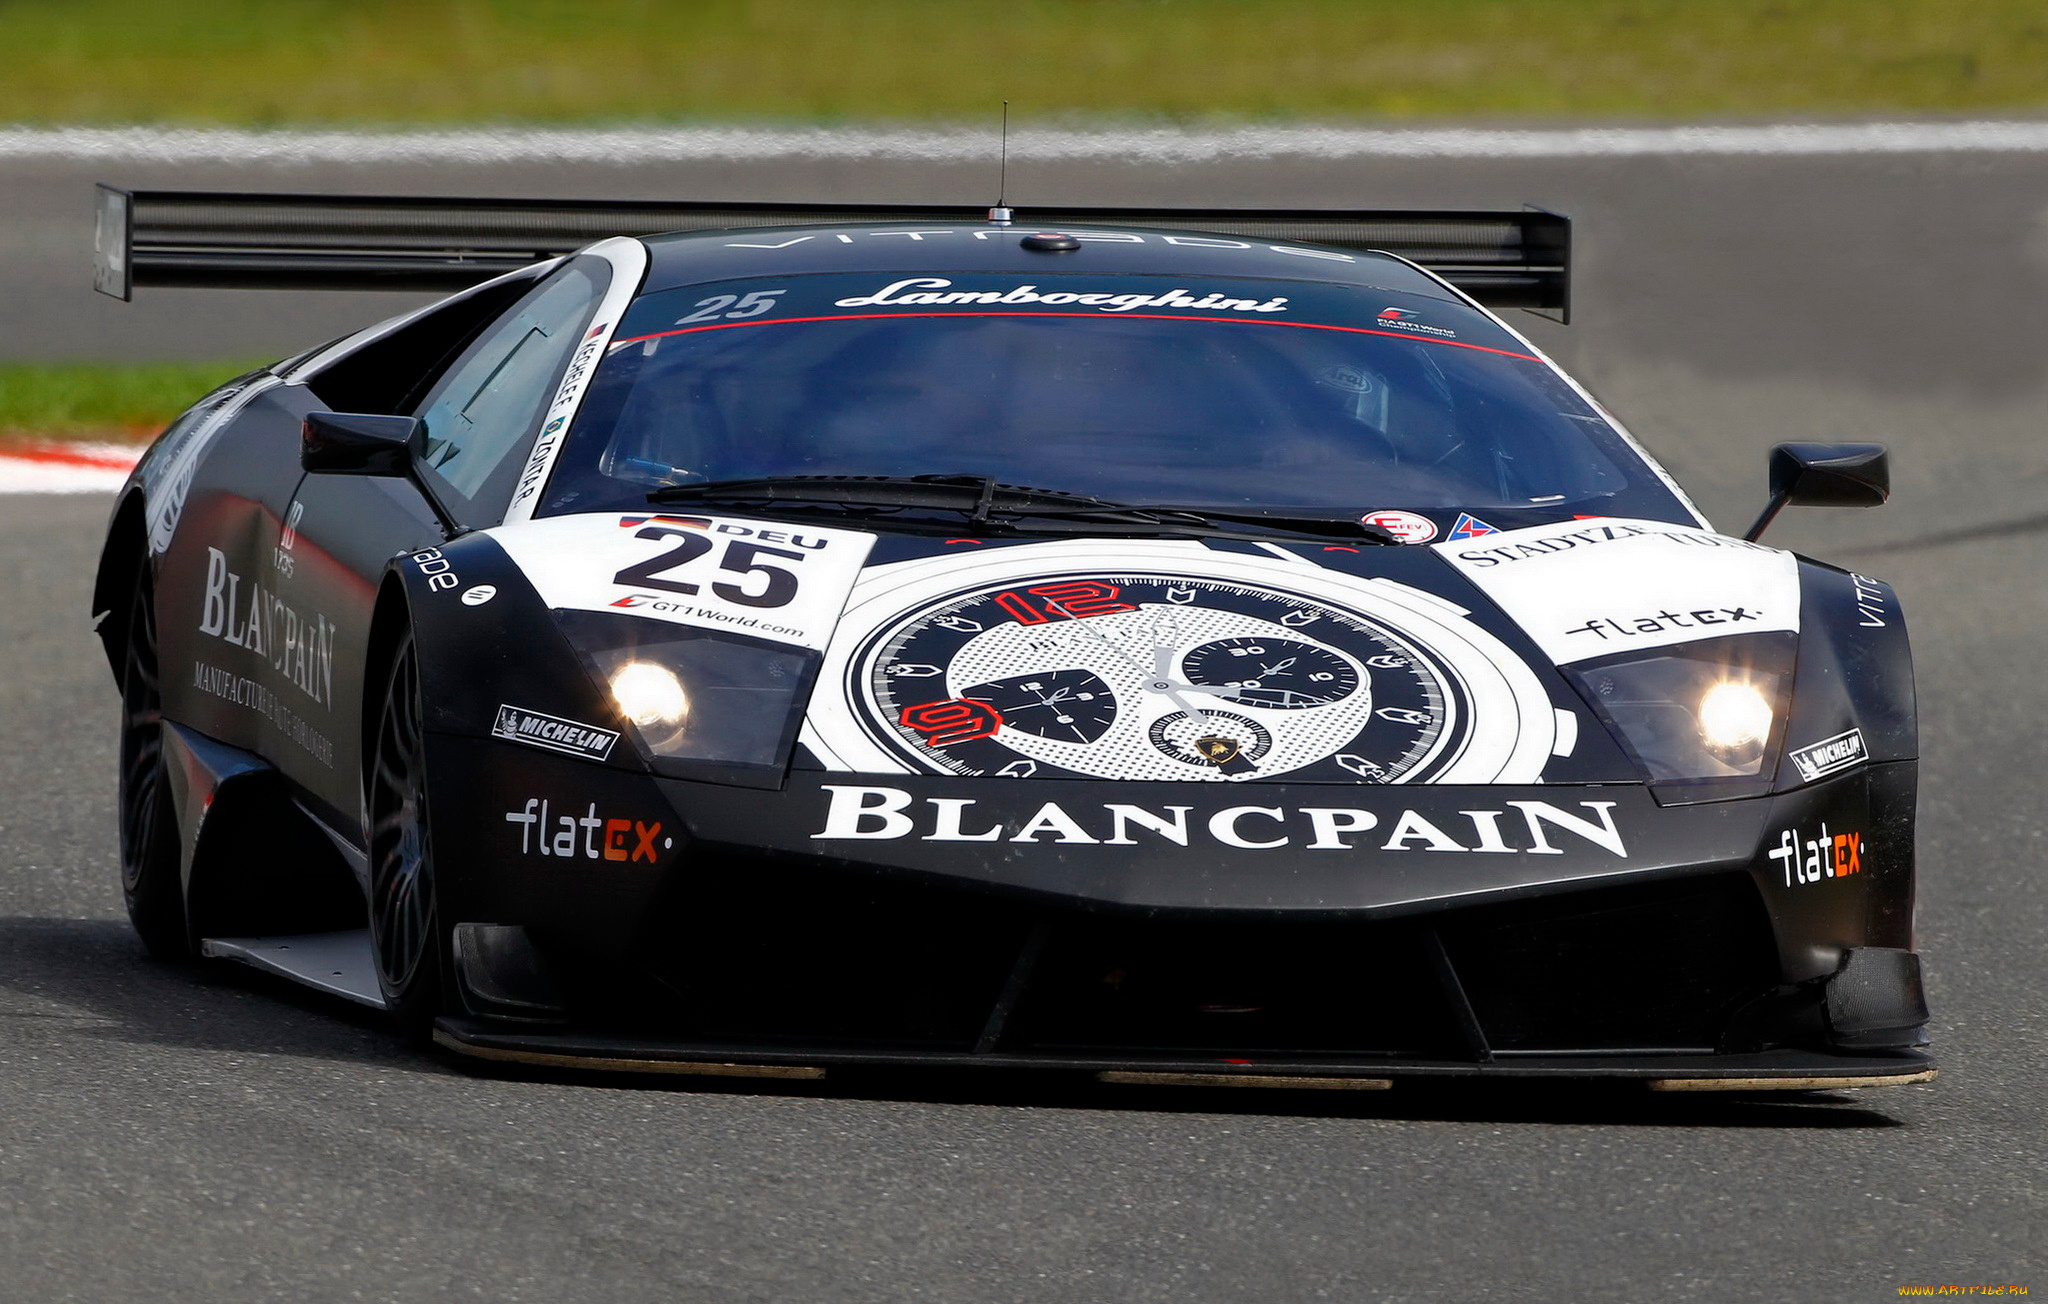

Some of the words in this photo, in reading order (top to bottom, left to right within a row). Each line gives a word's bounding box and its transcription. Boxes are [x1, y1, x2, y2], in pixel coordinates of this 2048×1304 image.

[674, 289, 787, 326] 25
[834, 277, 1288, 313] Lamborghini
[717, 523, 828, 551] DEU
[613, 527, 805, 608] 25
[994, 580, 1136, 626] 12
[199, 546, 336, 714] BLANCPAIN
[1308, 672, 1334, 682] 10
[519, 716, 612, 751] MICHELIN
[1812, 734, 1861, 766] MICHELIN
[810, 785, 1628, 858] BLANCPAIN
